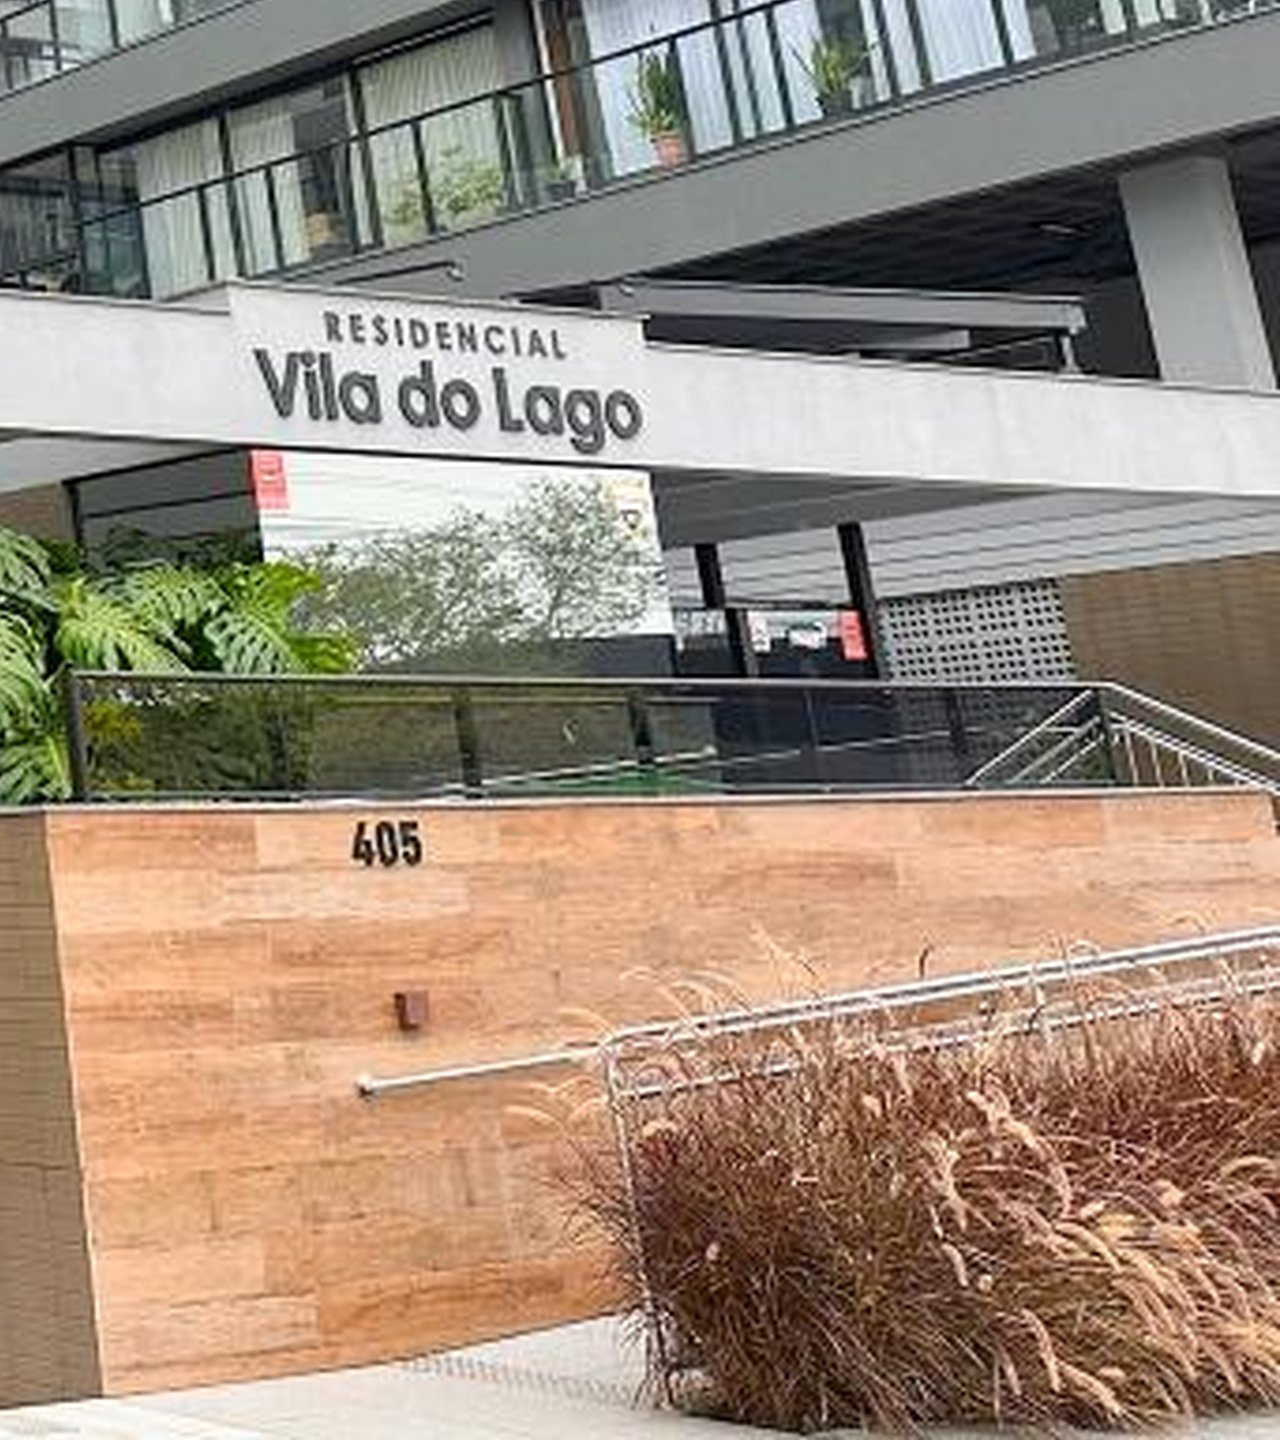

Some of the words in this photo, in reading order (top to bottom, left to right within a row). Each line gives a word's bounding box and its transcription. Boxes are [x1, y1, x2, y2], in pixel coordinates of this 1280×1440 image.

[323, 311, 568, 360] RESIDENCIAL
[252, 348, 384, 426] Vila
[397, 359, 483, 433] do
[491, 366, 643, 455] Lago
[352, 820, 423, 868] 405
